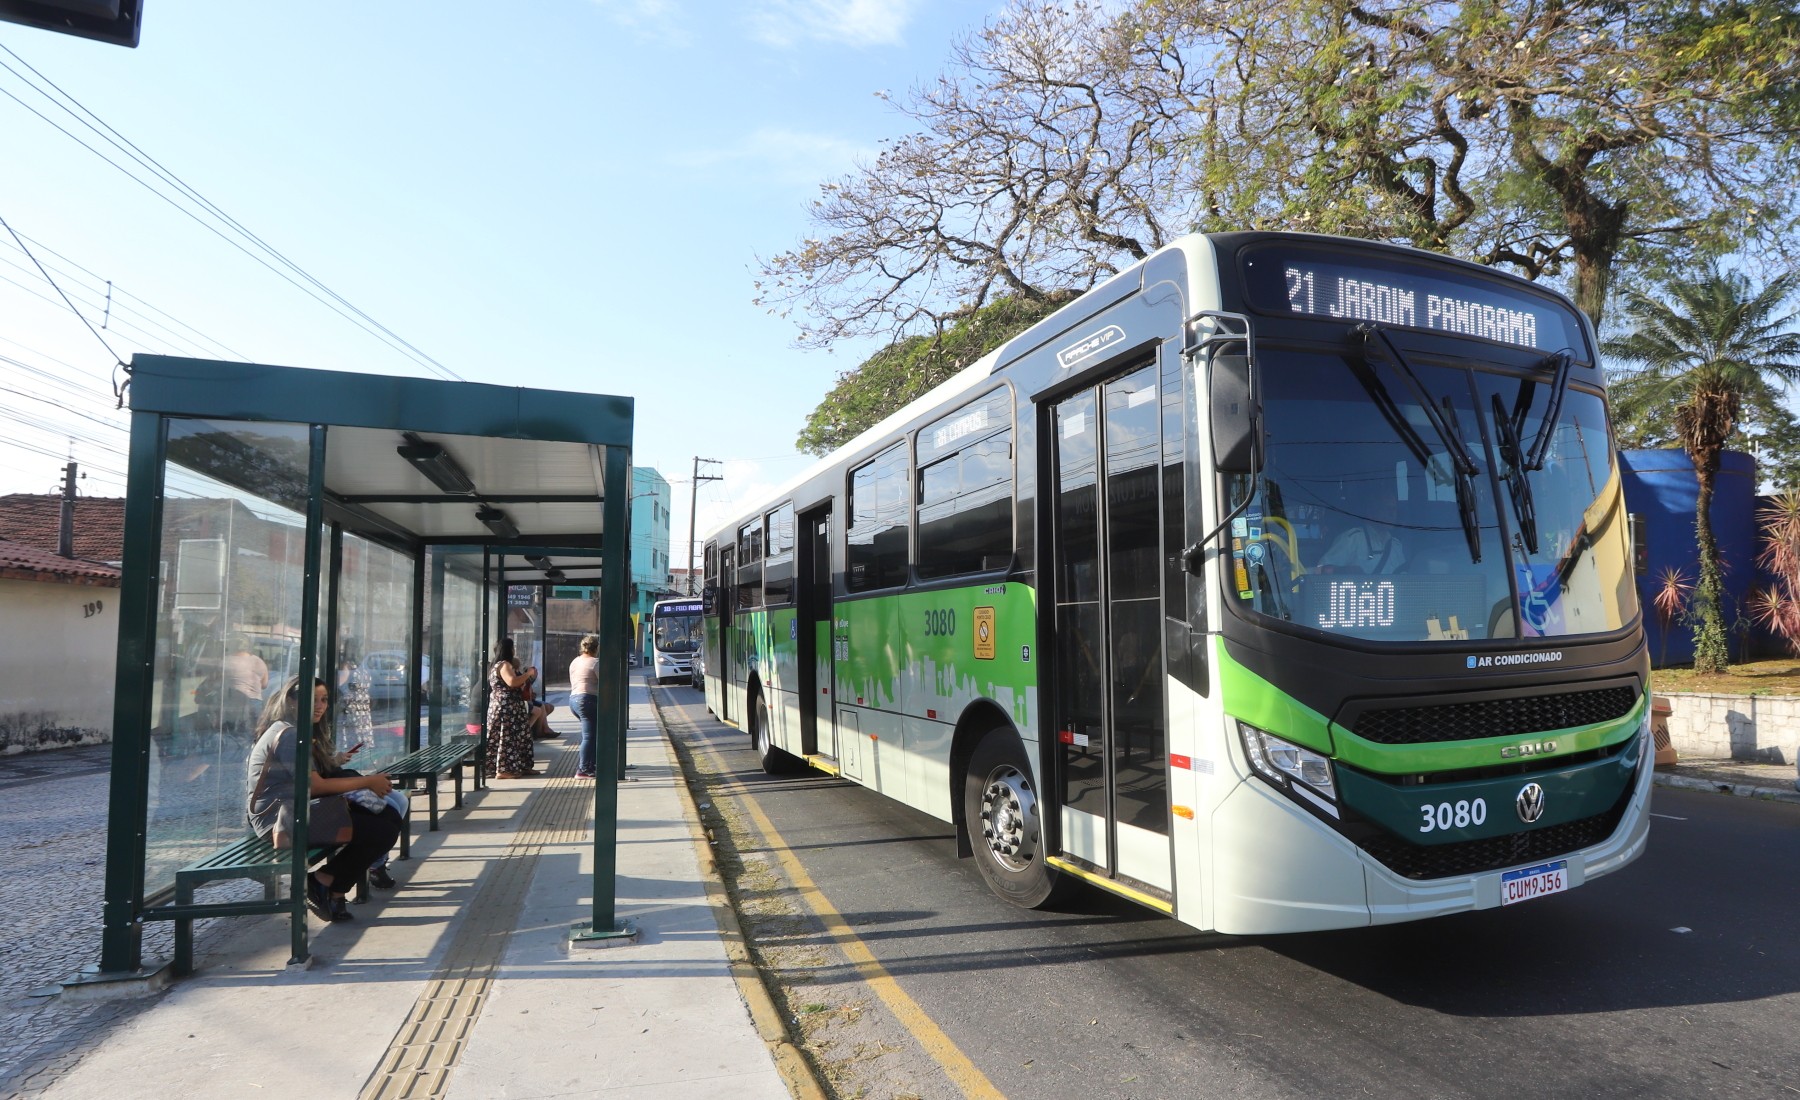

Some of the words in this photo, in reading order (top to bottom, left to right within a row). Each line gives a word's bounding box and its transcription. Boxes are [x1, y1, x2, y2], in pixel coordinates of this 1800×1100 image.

[1286, 268, 1314, 314] 21
[1329, 277, 1415, 327] JARDIM
[1427, 294, 1537, 348] PANORAMA
[1100, 330, 1115, 343] VIP
[82, 600, 103, 618] 199
[1319, 582, 1394, 628] JOÃO
[924, 608, 956, 637] 3080
[1478, 656, 1493, 667] AR
[1494, 651, 1563, 666] CONDICIONADO
[1501, 741, 1557, 759] CAIO
[1419, 797, 1487, 833] 3080
[1508, 872, 1561, 900] CUM9J56
